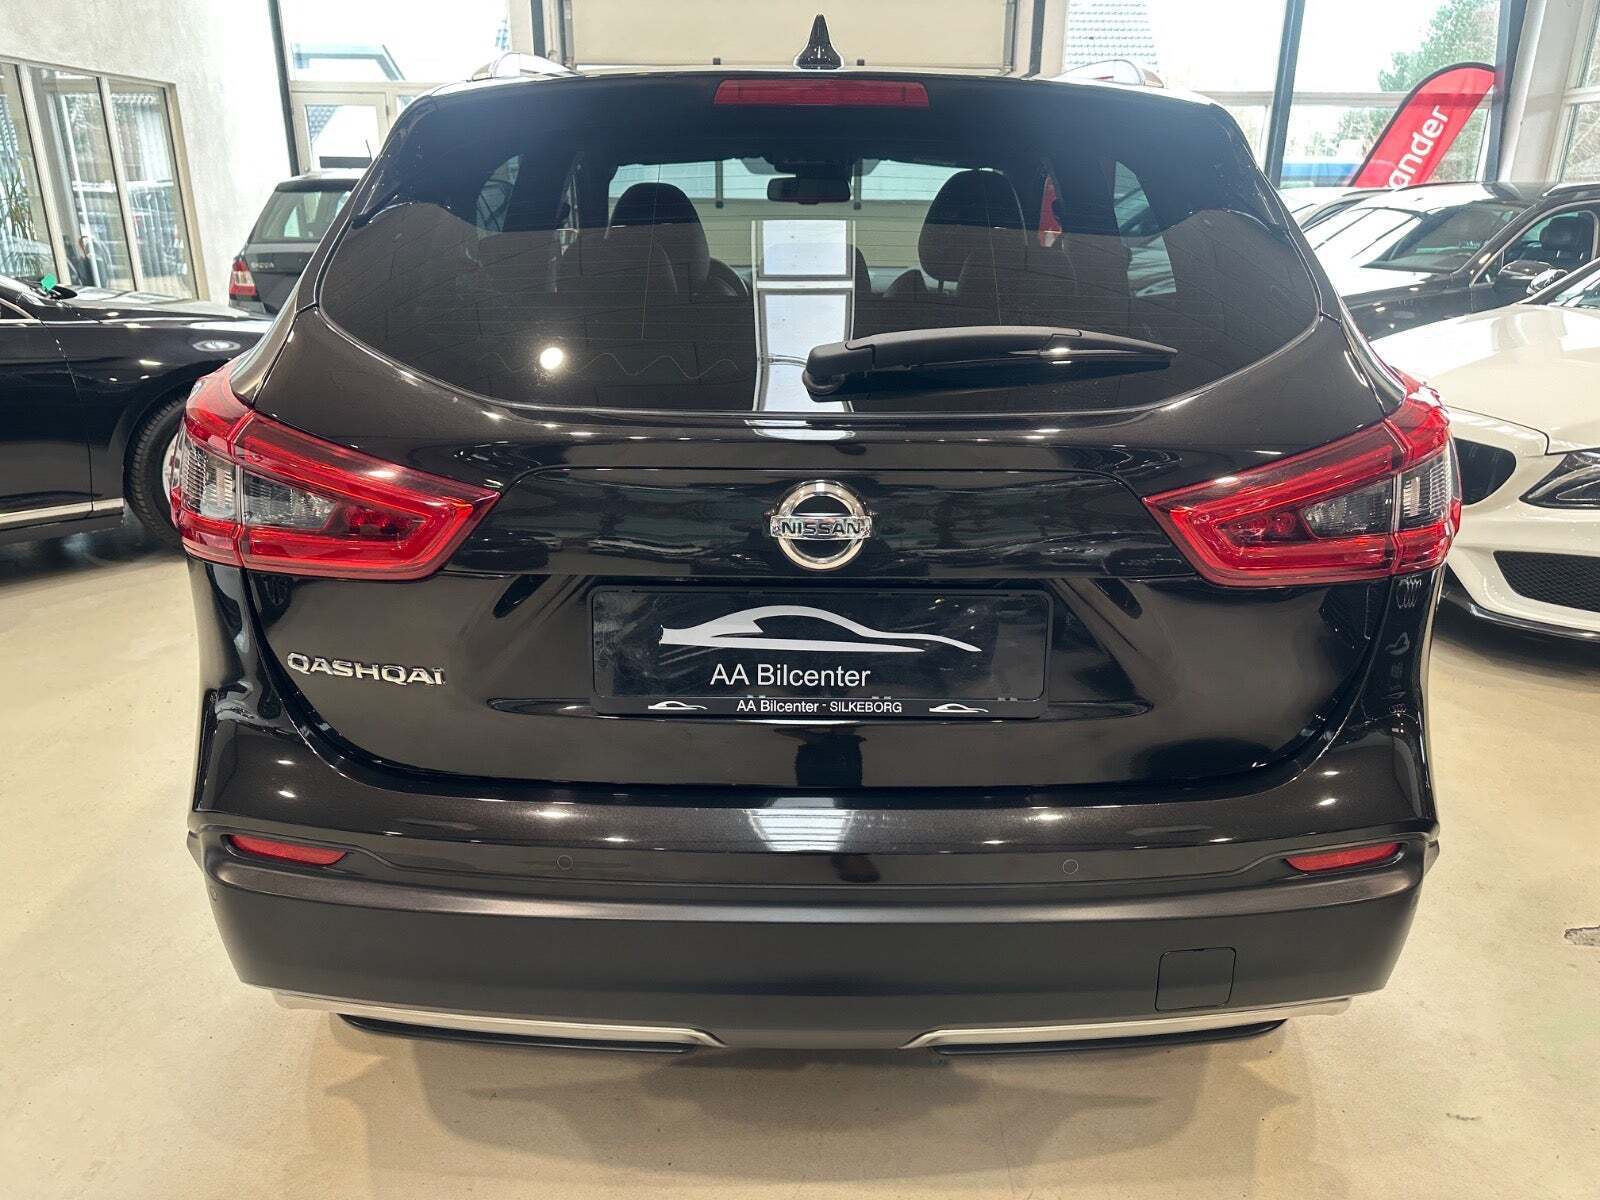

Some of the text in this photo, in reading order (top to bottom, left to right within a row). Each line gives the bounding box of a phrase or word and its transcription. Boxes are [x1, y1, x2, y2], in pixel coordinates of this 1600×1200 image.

[1388, 105, 1449, 189] ander
[780, 521, 861, 535] NISSAN
[287, 652, 446, 686] QASHQAI
[709, 663, 871, 687] AA Bilcenter
[736, 699, 757, 712] AA
[760, 699, 820, 713] Bilcenter
[829, 701, 902, 713] SILKEBORG
